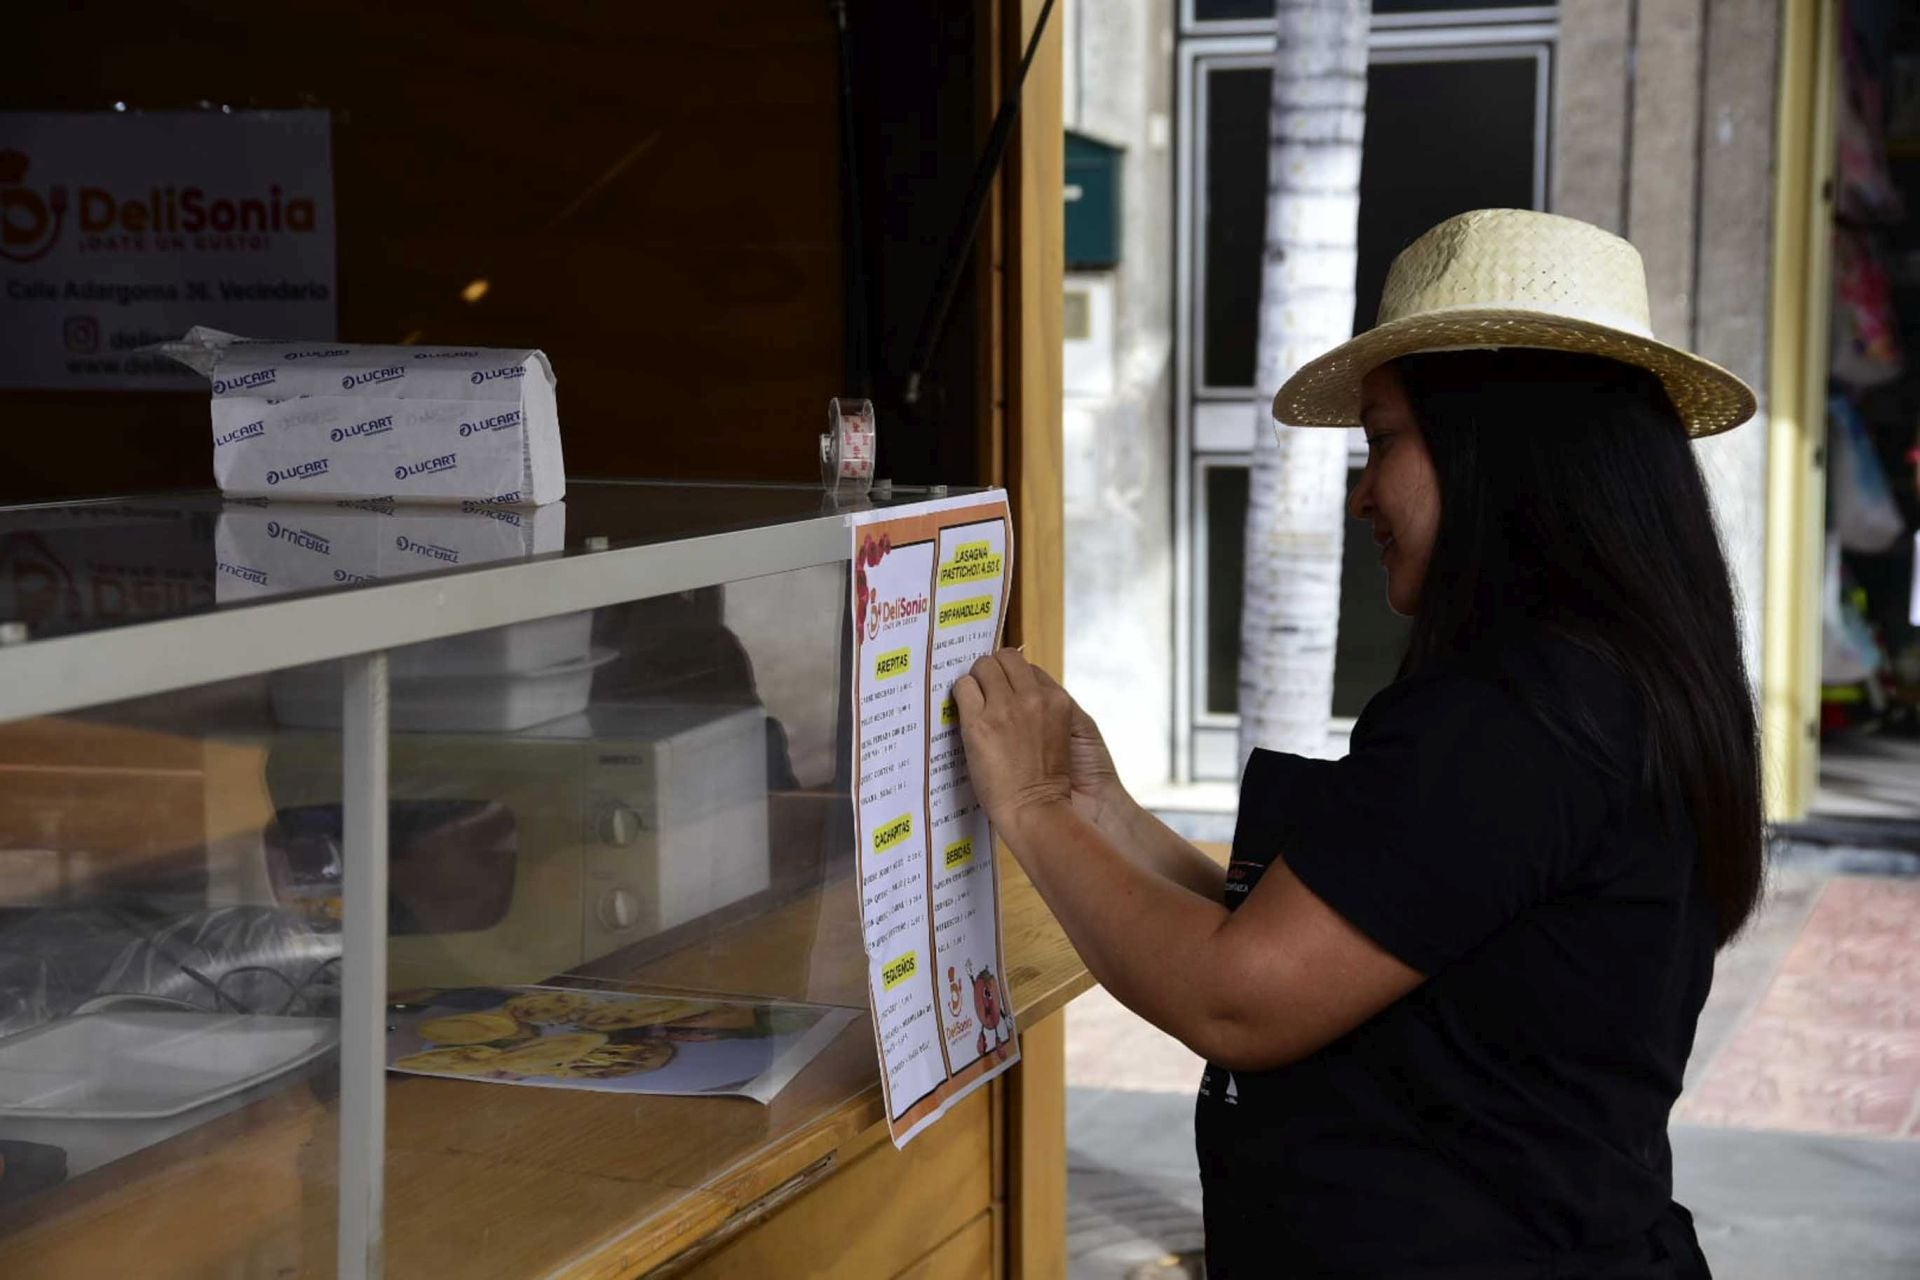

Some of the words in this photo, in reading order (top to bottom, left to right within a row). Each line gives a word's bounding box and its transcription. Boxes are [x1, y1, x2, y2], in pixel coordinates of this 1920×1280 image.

[79, 184, 315, 233] DeliSonia
[219, 278, 328, 301] Vecindario
[226, 368, 277, 390] LUCART
[356, 366, 406, 384] LUCART
[344, 416, 393, 437] LUCART
[473, 410, 521, 432] LUCART
[216, 421, 265, 447] LUCART
[280, 458, 329, 481] LUCART
[408, 453, 457, 475] LUCART
[955, 547, 988, 563] LASAGNA
[882, 593, 928, 623] DeliSonia
[939, 601, 991, 624] EMPANADILLAS
[876, 654, 908, 676] AREPITAS
[874, 819, 910, 849] CACHAPITAS
[945, 843, 972, 865] BEBIDAS
[882, 957, 916, 985] TEQUEÑOS
